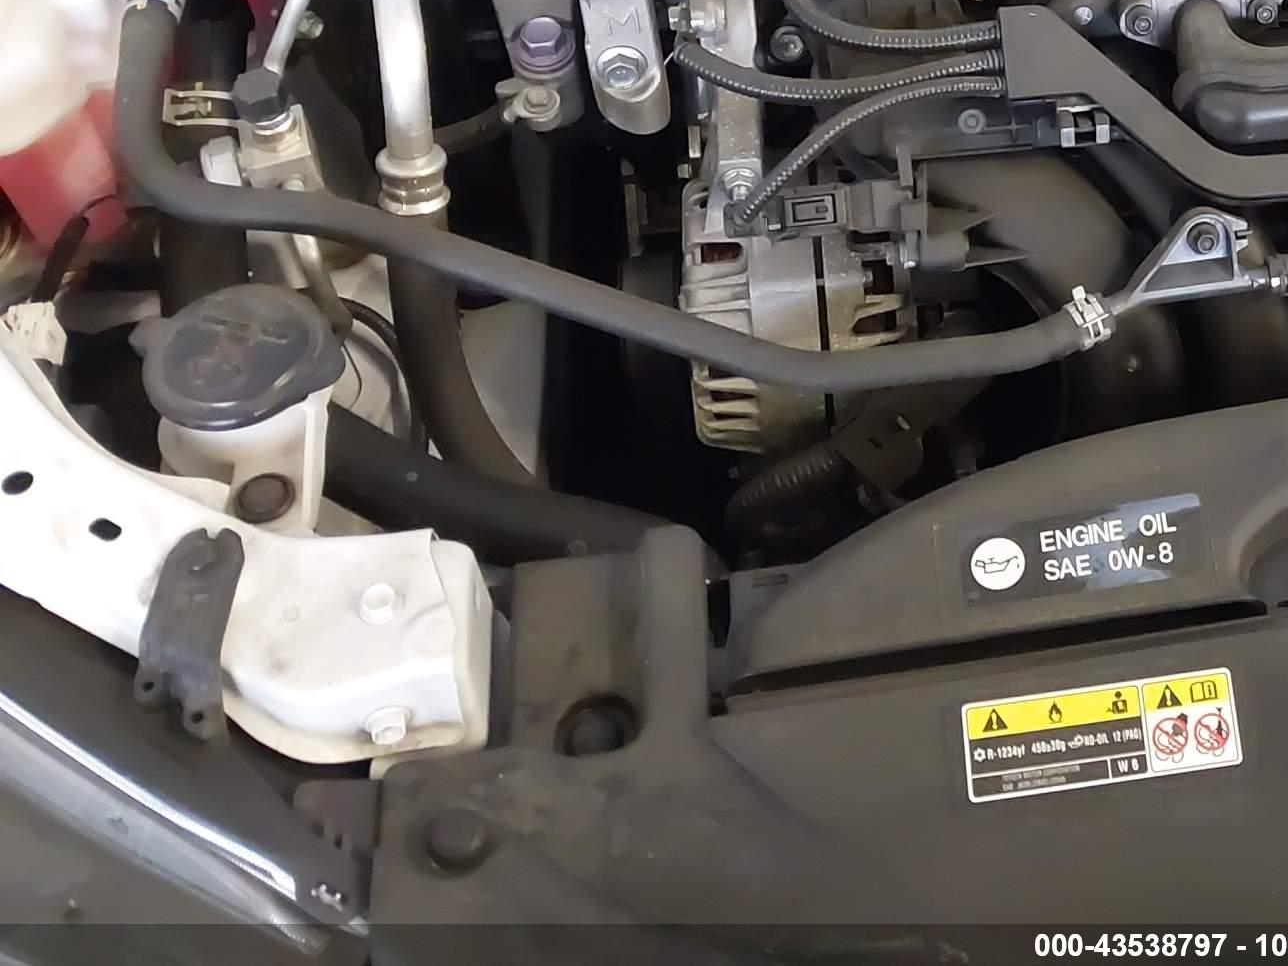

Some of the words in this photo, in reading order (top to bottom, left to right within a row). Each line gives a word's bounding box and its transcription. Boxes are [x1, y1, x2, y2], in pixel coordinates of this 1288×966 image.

[1039, 519, 1126, 553] ENGINE
[1138, 512, 1178, 537] OIL
[1044, 554, 1092, 581] SAE
[1108, 542, 1175, 572] 0W-8
